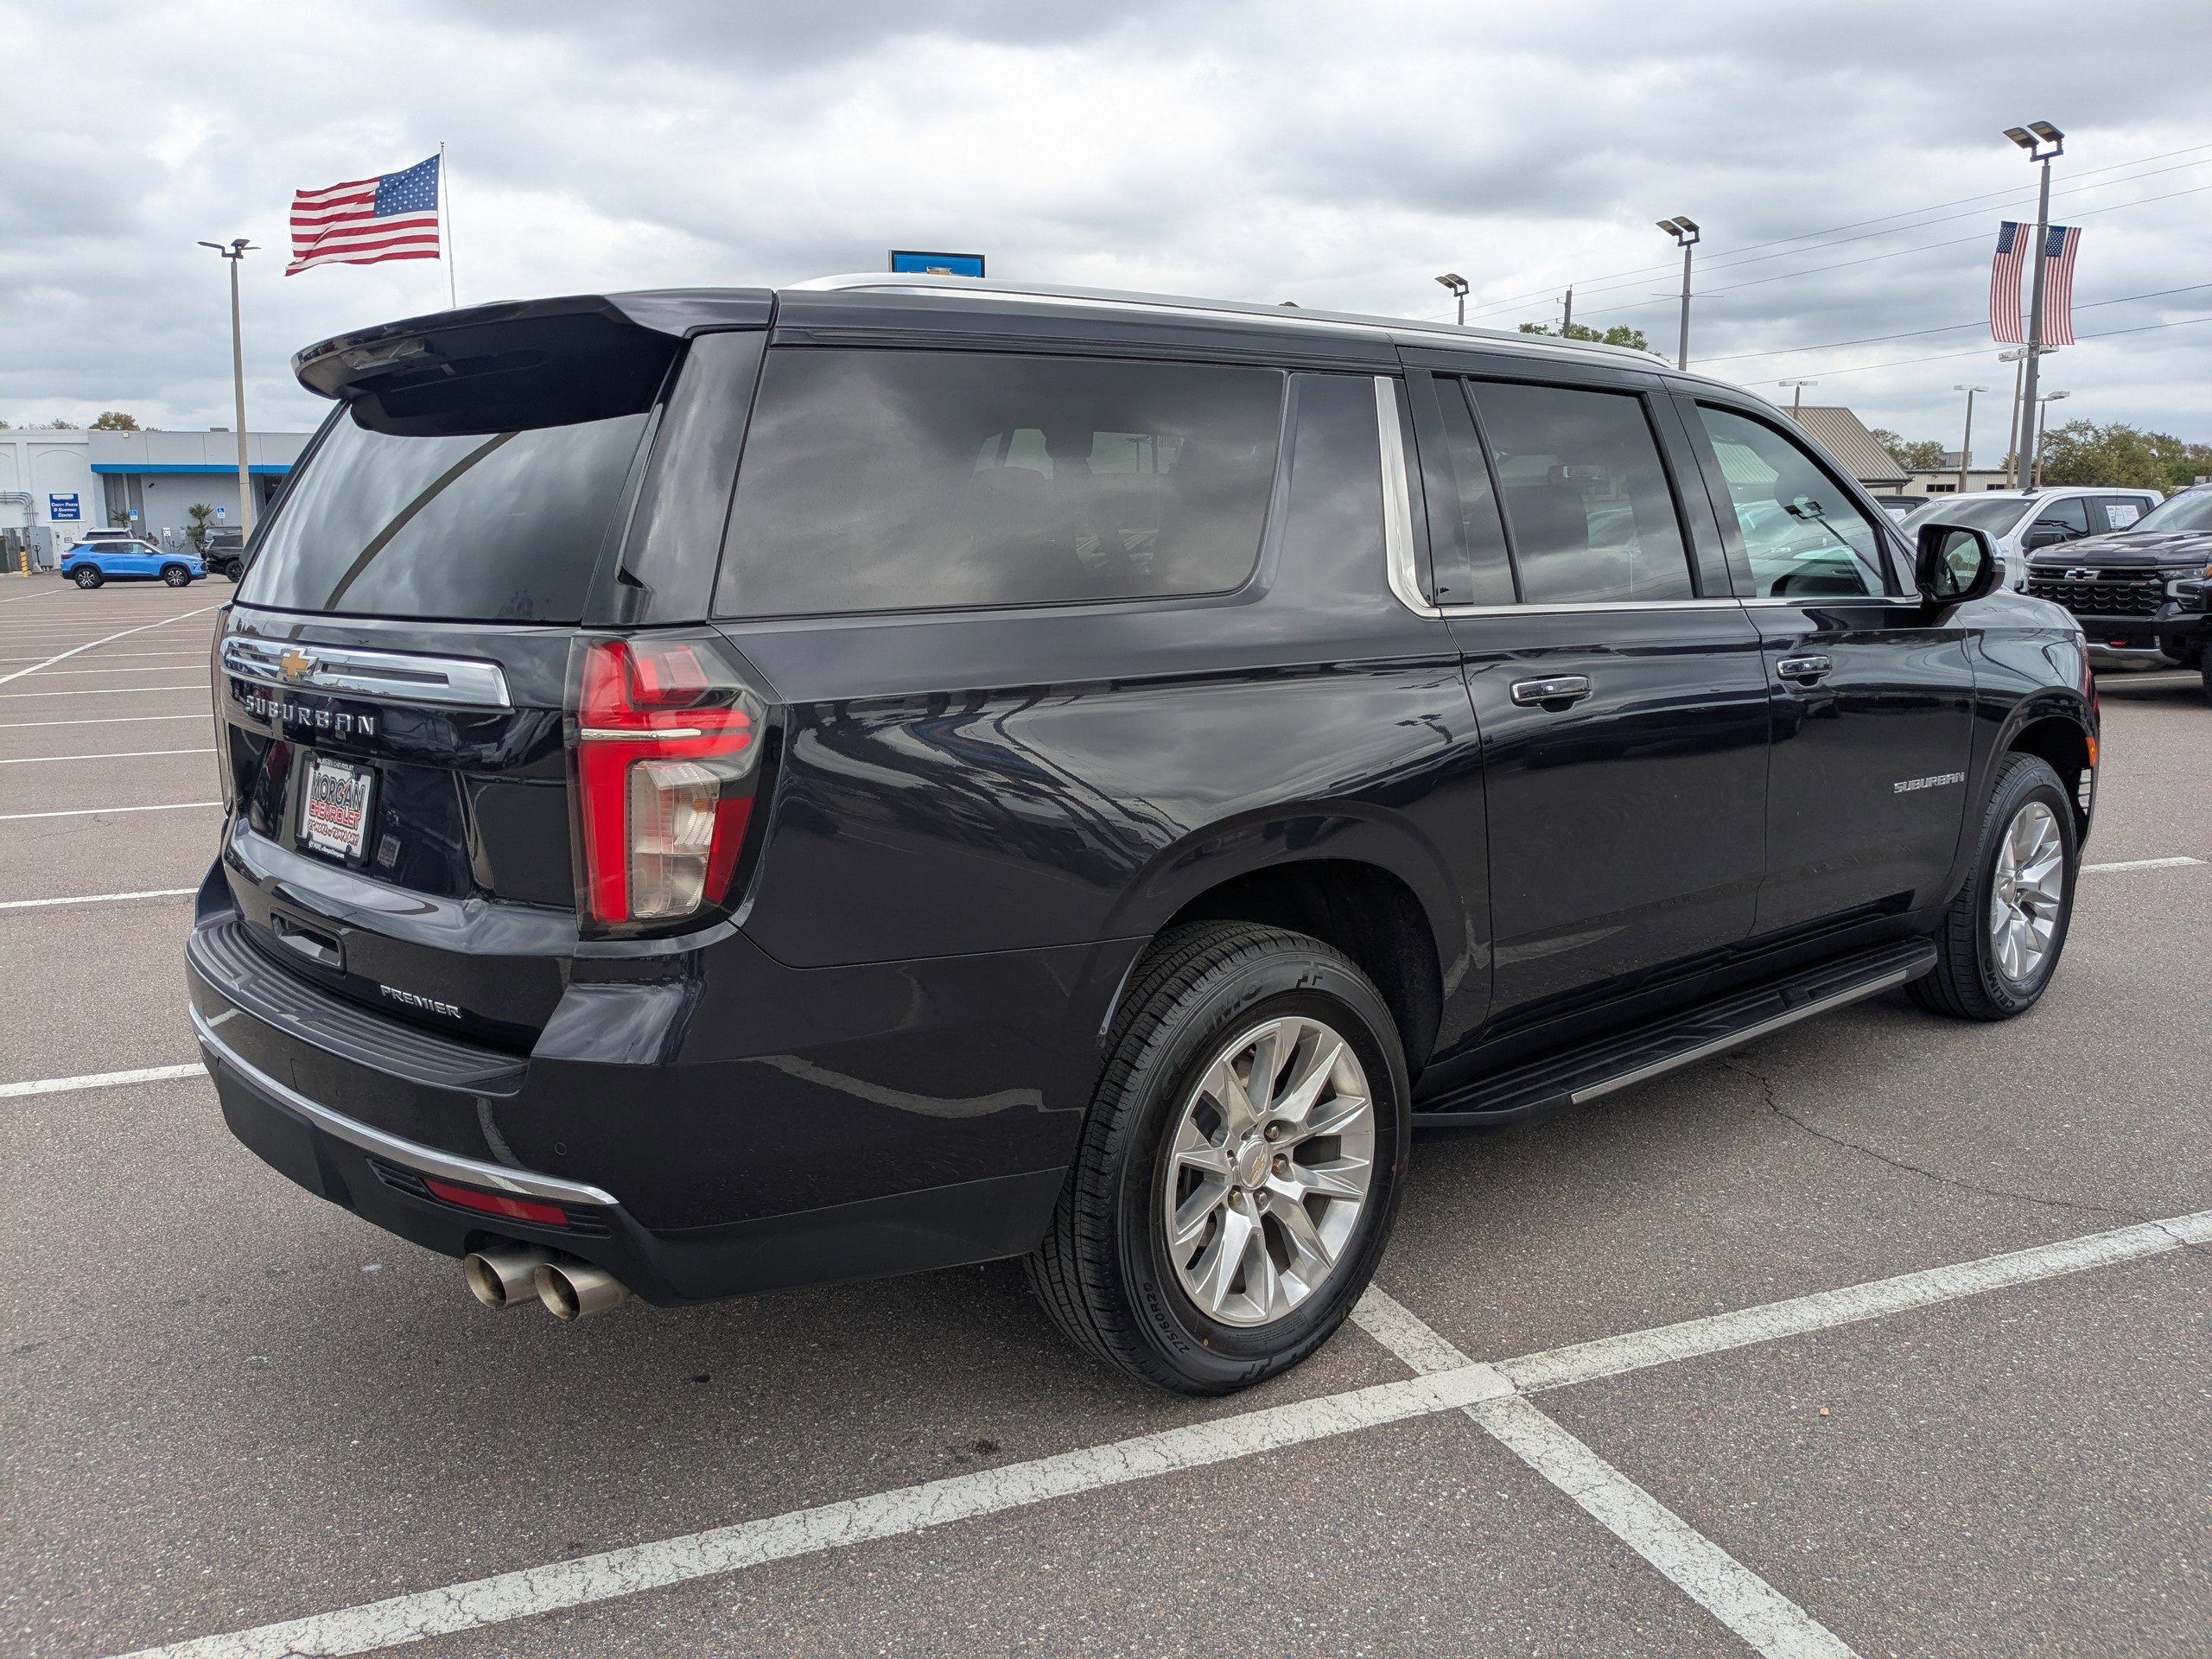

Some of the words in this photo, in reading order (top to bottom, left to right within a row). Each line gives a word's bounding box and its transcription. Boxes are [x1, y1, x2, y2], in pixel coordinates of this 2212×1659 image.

[245, 695, 375, 735] SUBURBAN
[311, 772, 366, 812] MORGAN
[1893, 772, 1965, 793] SUBURBAN
[309, 798, 361, 830] CHEVROLET
[380, 984, 462, 1019] PREMIER
[1143, 1282, 1191, 1354] 275/60R20
